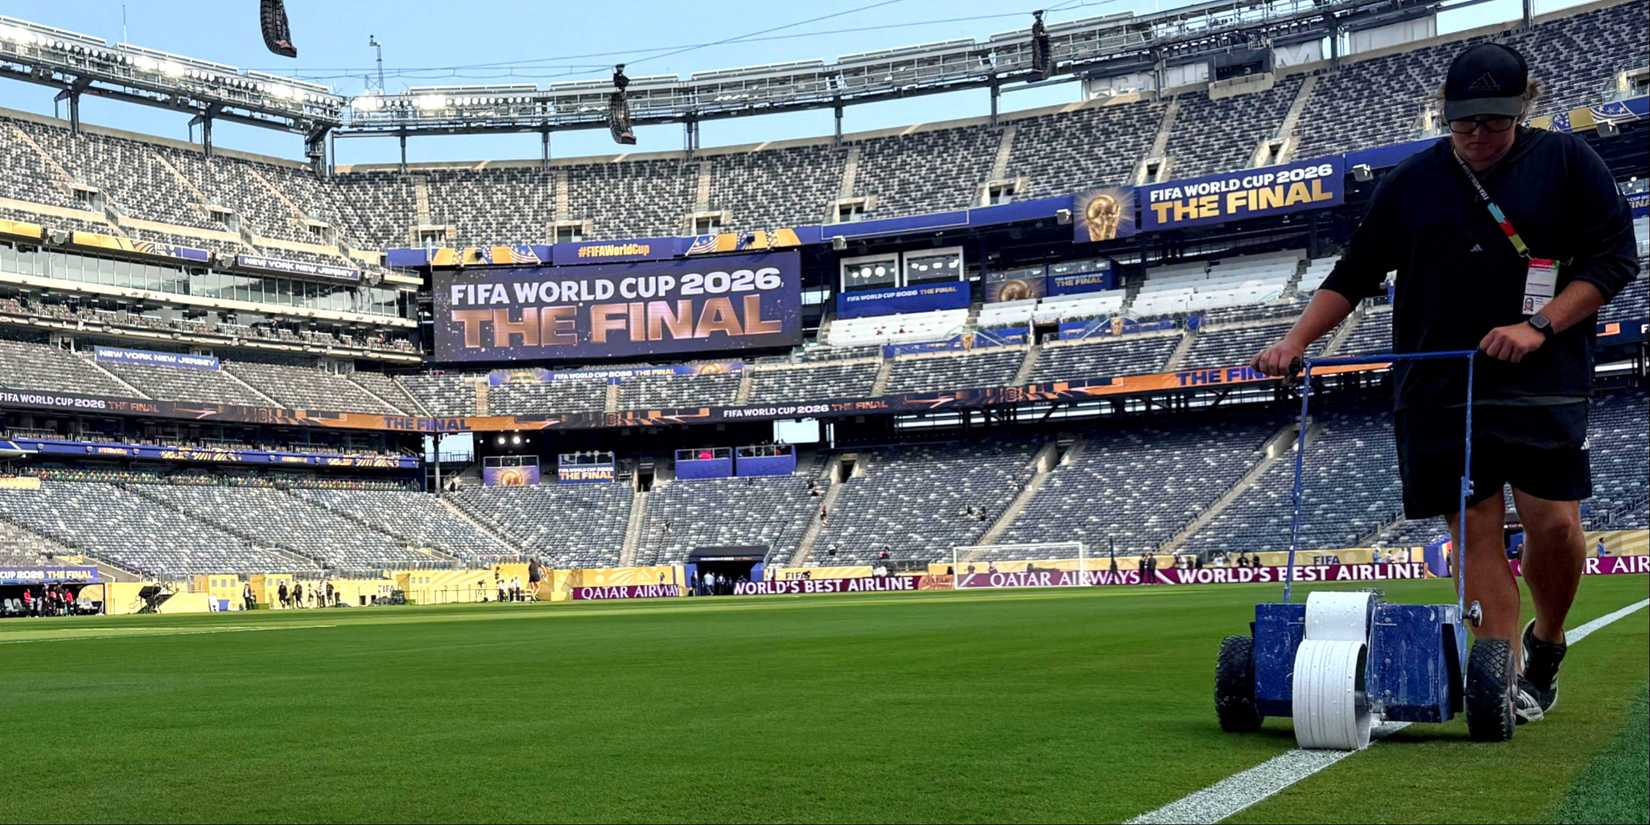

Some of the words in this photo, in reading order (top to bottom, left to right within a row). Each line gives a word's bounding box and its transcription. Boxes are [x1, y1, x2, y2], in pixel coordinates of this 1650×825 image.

[1150, 187, 1183, 202] FIFA
[1184, 178, 1240, 197] WORLD
[1242, 173, 1275, 188] CUP
[1276, 164, 1333, 184] 2026
[1151, 194, 1220, 224] THE
[1226, 179, 1333, 214] FINAL
[578, 243, 650, 258] #FIFAWorldCup
[244, 258, 266, 267] NEW
[268, 260, 295, 270] YORK
[295, 263, 317, 273] NEW
[318, 266, 354, 277] JERSEY
[451, 282, 510, 306] FIFA
[513, 279, 615, 304] WORLD
[619, 275, 676, 299] CUP
[680, 267, 781, 296] 2026
[451, 305, 578, 348] THE
[590, 294, 783, 343] FINAL
[99, 350, 123, 358] NEW
[124, 351, 153, 360] YORK
[154, 354, 176, 362] NEW
[178, 356, 215, 367] JERSEY
[569, 371, 593, 379] WORLD
[1176, 368, 1221, 385] THE
[1227, 366, 1265, 381] FIN
[0, 392, 19, 402] FIFA
[20, 393, 54, 405] WORLD
[55, 396, 74, 407] CUP
[74, 398, 106, 409] 2026
[108, 400, 129, 410] THE
[130, 402, 160, 413] FINAL
[723, 408, 743, 418] FIFA
[744, 406, 777, 416] WORLD
[777, 405, 796, 415] CUP
[797, 404, 829, 414] 2026
[831, 403, 854, 411] THE
[855, 400, 888, 409] FINAL
[384, 416, 414, 430] THE
[416, 417, 471, 431] FINAL
[560, 471, 581, 480] THE
[581, 470, 614, 480] FINAL
[1313, 555, 1341, 565] FIFA
[1612, 556, 1649, 574] AIR
[0, 570, 16, 579] CUP
[17, 570, 45, 579] 2026
[46, 570, 65, 579] THE
[65, 570, 94, 579] FINAL
[990, 572, 1053, 587] QATAR
[1059, 569, 1141, 586] AIRWAYS
[1177, 566, 1271, 584] WORLD'S
[1278, 566, 1335, 582] BEST
[1336, 563, 1422, 580] AIRLINE
[581, 586, 628, 600] QATAR
[733, 579, 799, 595] WORLD'S
[804, 578, 843, 593] BEST
[848, 576, 914, 591] AIRLINE
